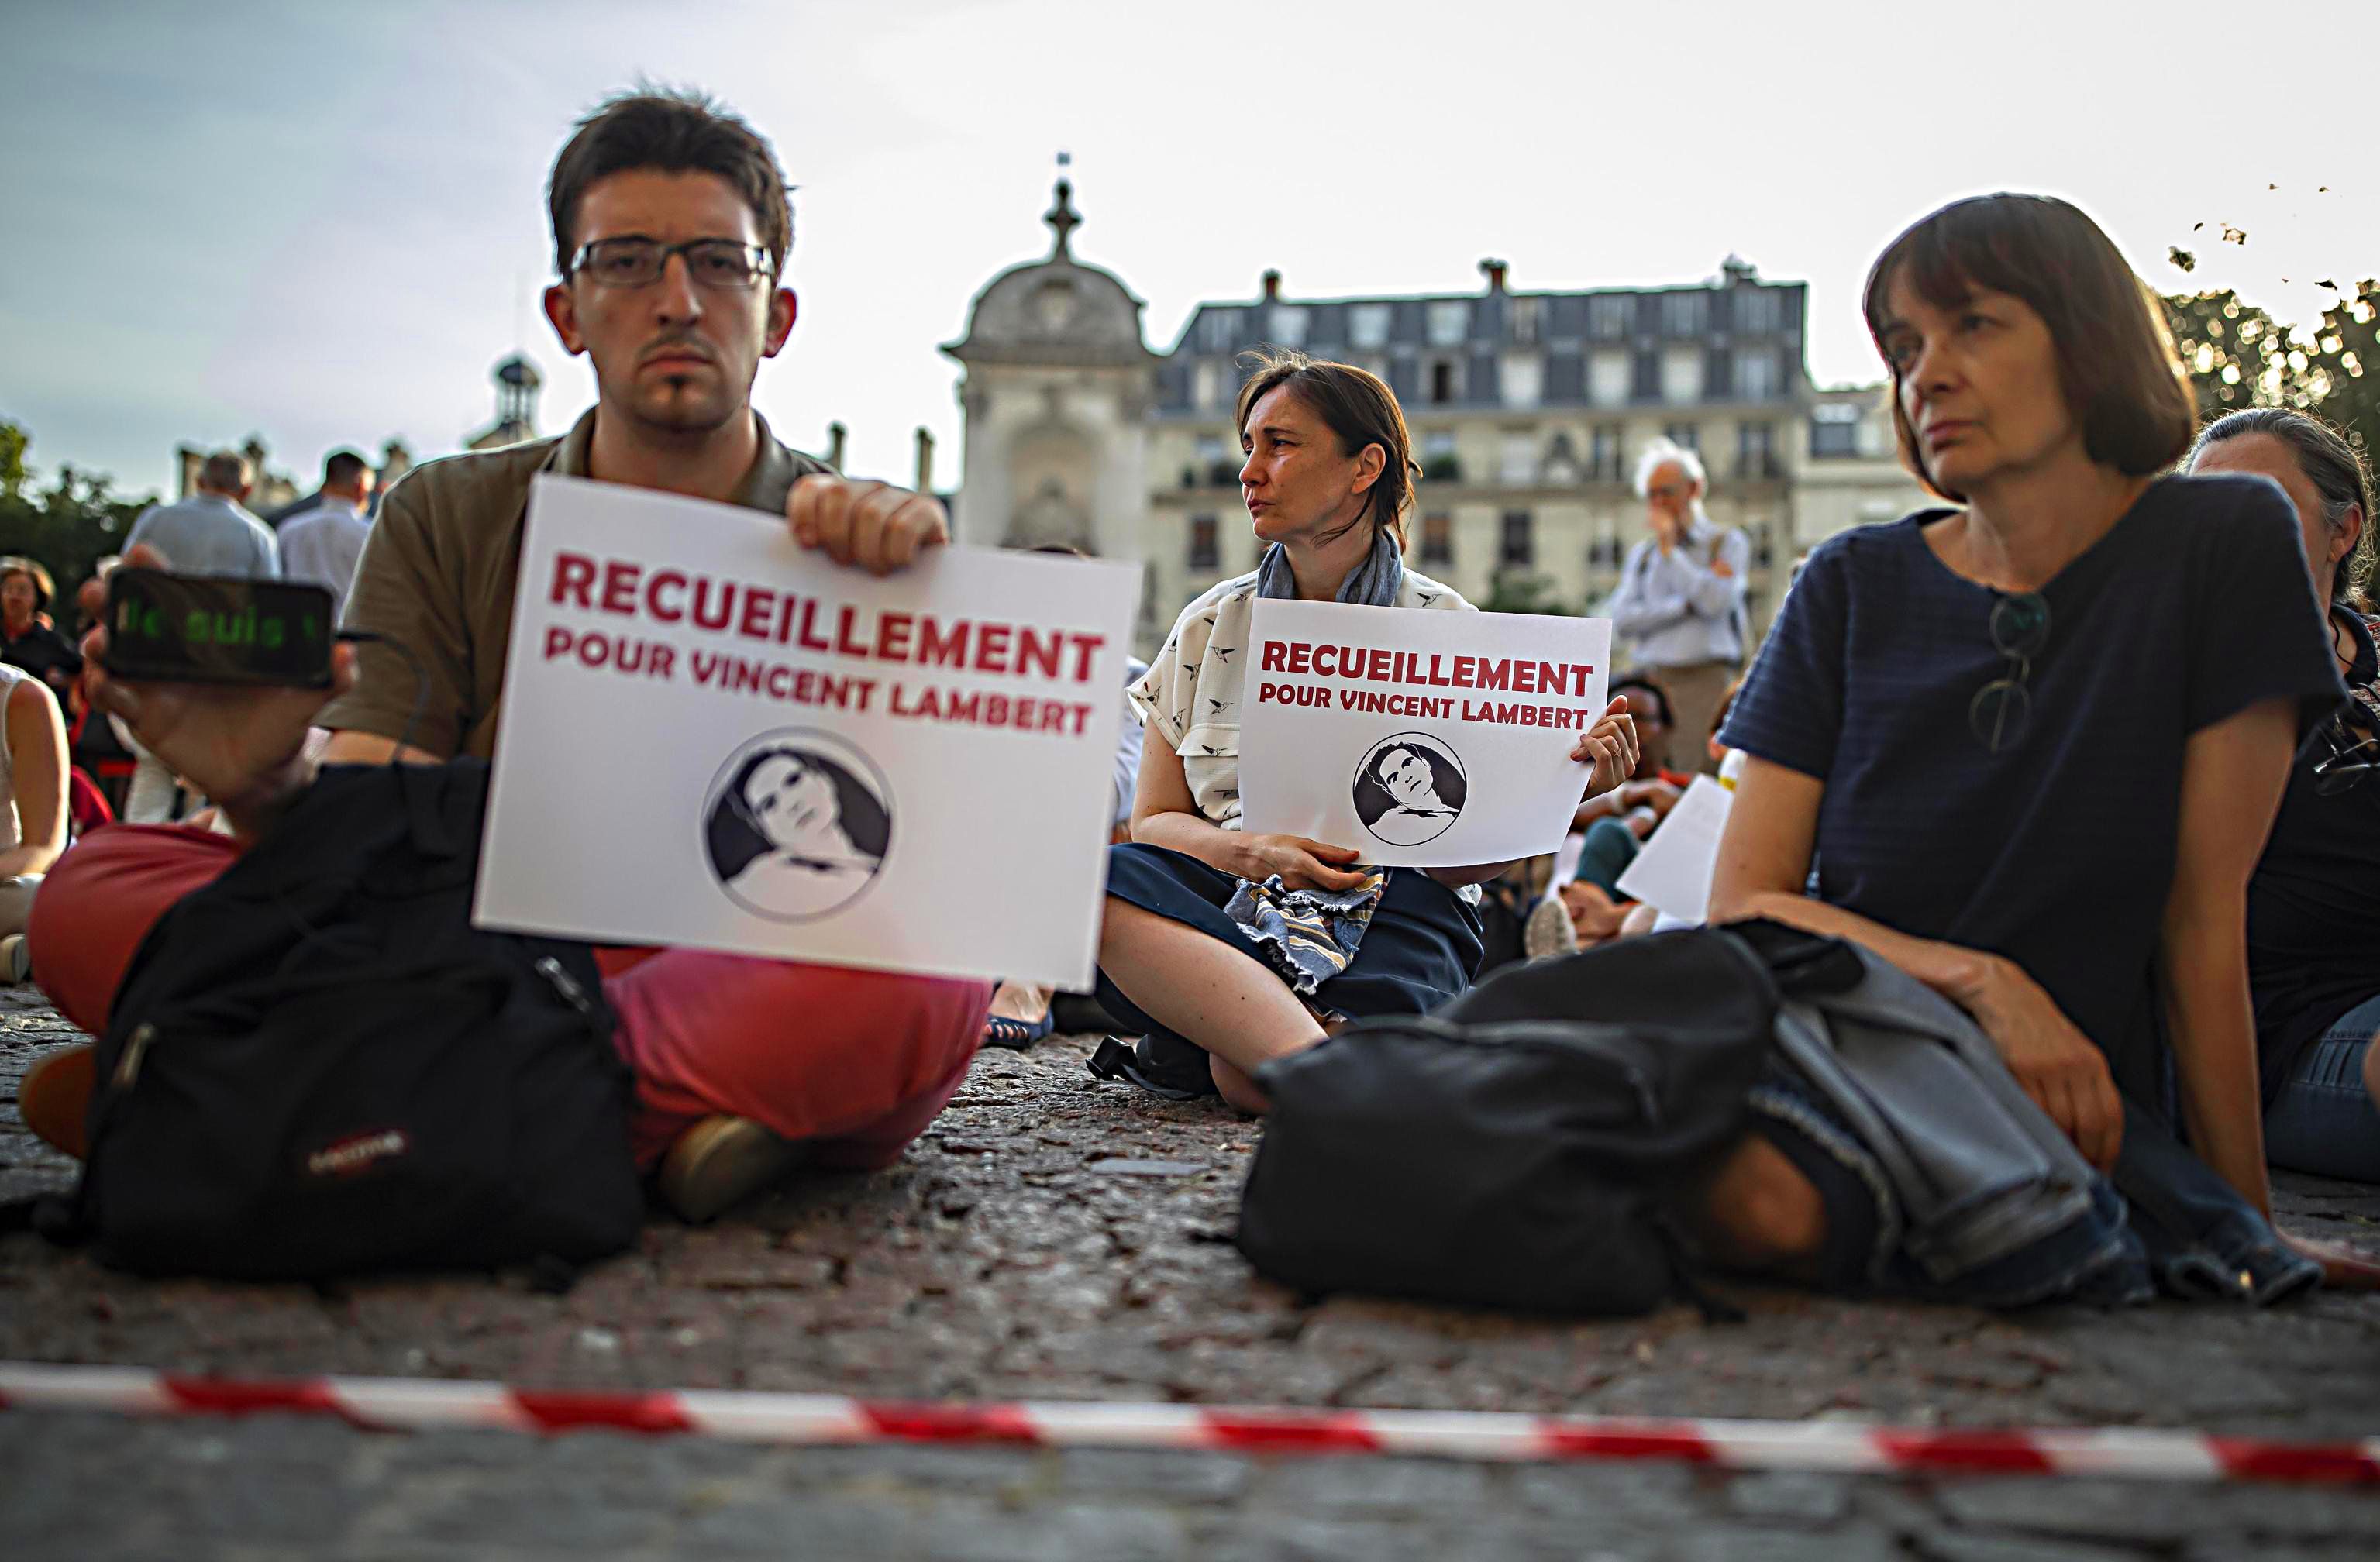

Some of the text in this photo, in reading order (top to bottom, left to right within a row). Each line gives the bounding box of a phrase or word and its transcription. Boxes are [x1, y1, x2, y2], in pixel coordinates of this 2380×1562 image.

[186, 607, 284, 649] suis
[550, 553, 1106, 683] RECUEILLEMENT
[545, 627, 1092, 735] POUR VINCENT LAMBERT
[1261, 640, 1593, 697] RECUEILLEMENT
[1259, 683, 1589, 731] POUR VINCENT LAMBERT
